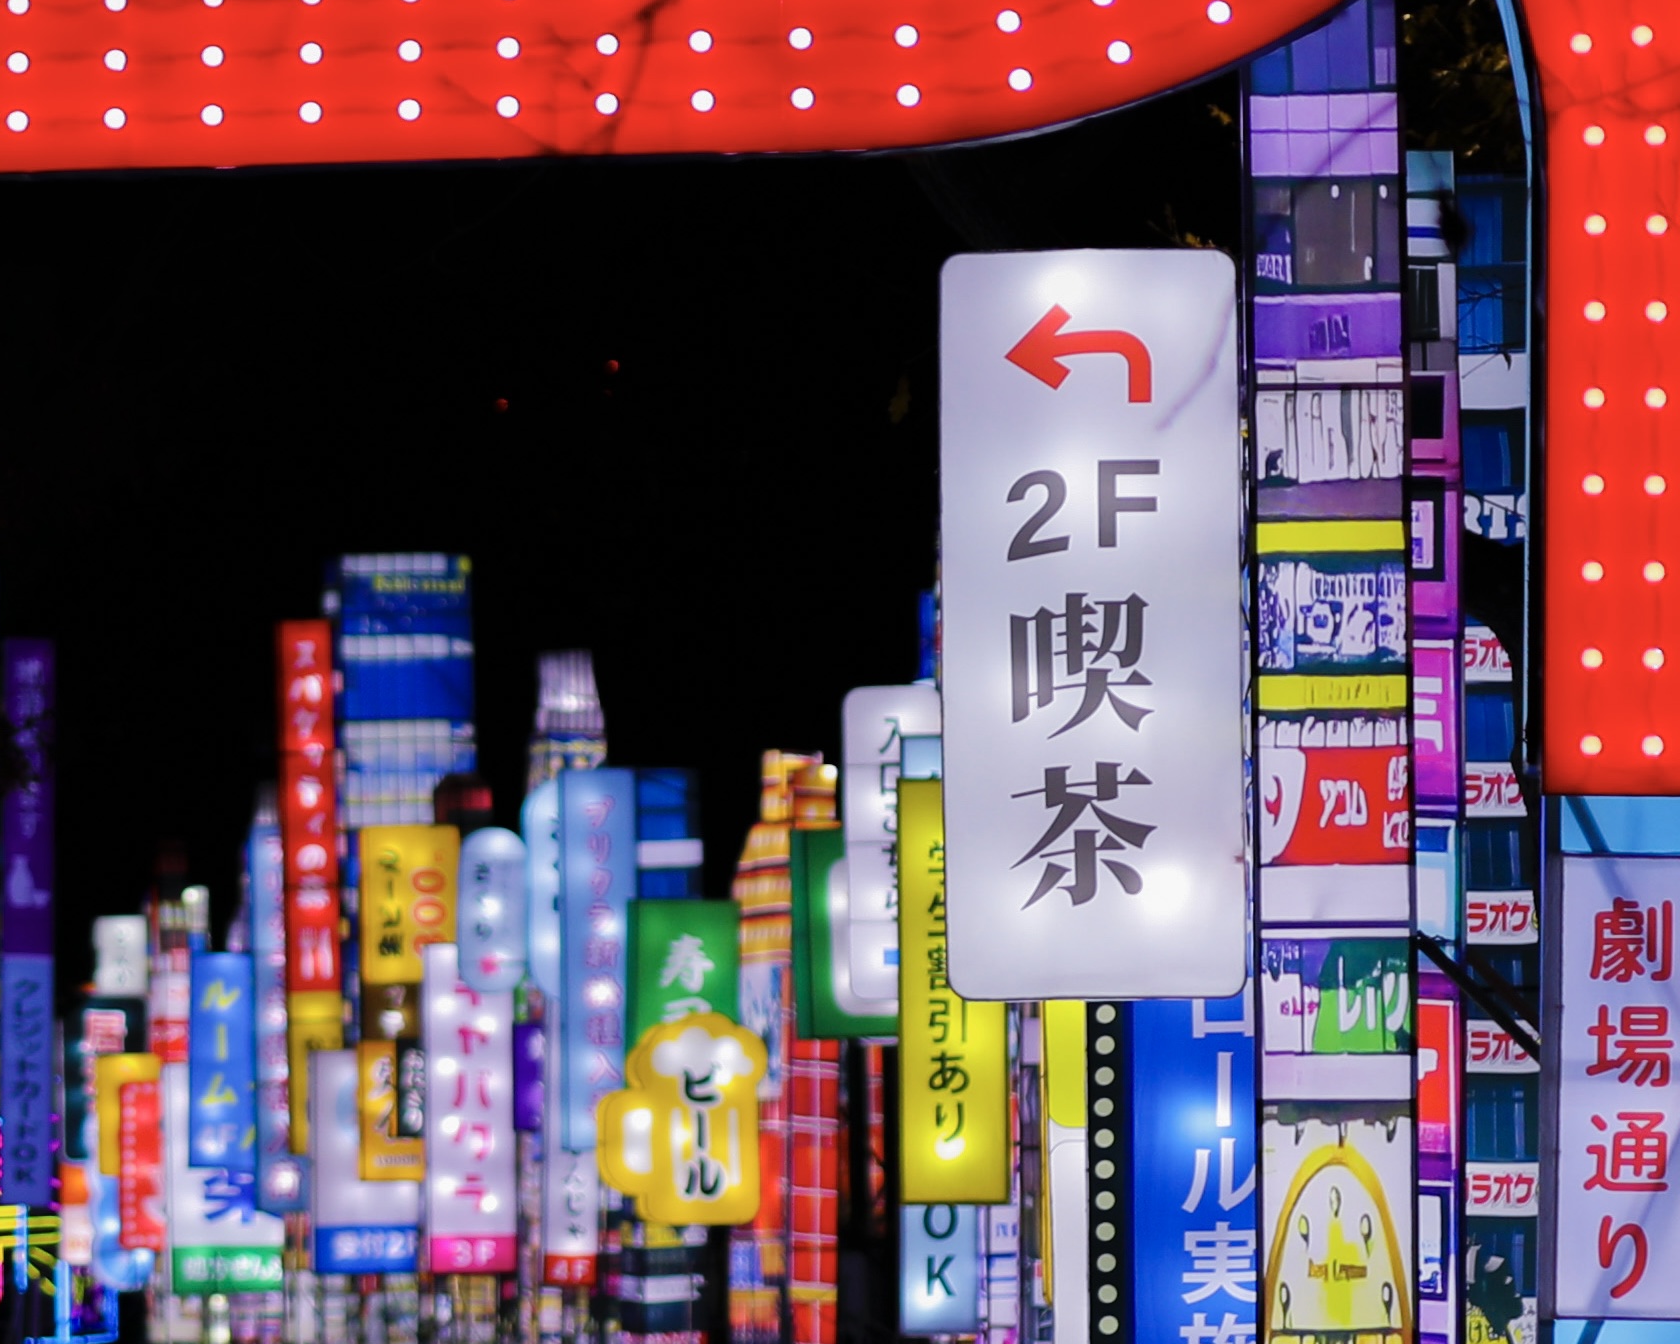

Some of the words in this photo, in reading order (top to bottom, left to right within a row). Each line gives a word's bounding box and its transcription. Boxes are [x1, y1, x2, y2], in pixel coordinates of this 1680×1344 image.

[1004, 458, 1161, 562] 2F
[1008, 591, 1156, 912] 喫茶
[683, 1063, 723, 1196] ビール
[1582, 895, 1675, 1300] 劇場通り
[1465, 1173, 1535, 1206] ラオケ
[922, 1203, 959, 1298] OK
